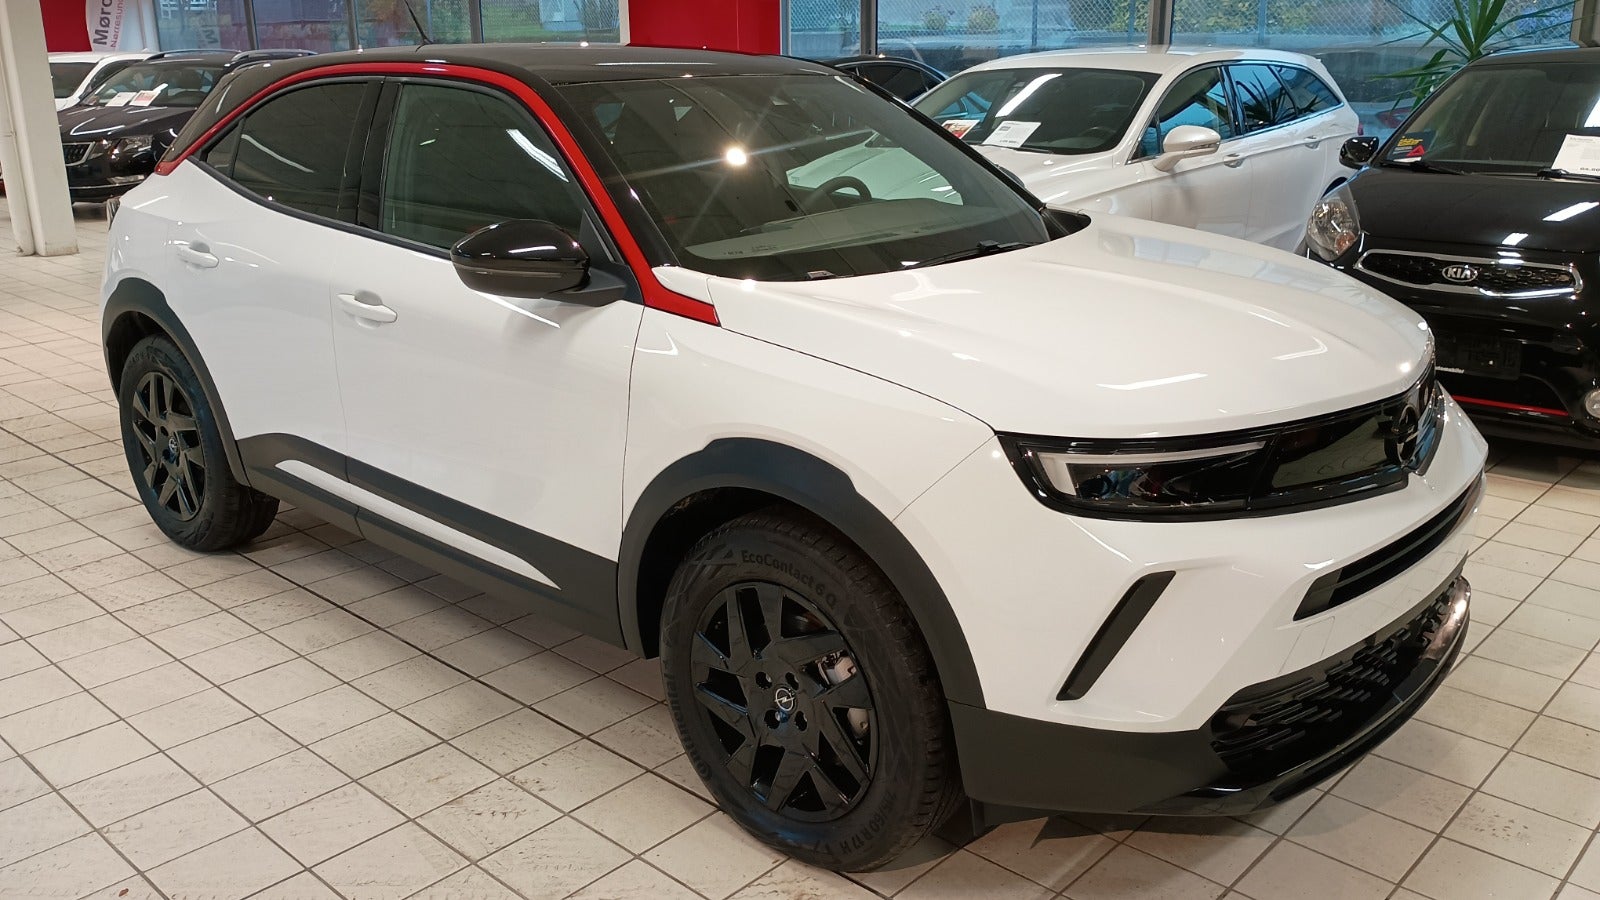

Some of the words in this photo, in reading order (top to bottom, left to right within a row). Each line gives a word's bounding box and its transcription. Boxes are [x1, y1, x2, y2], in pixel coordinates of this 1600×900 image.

[1447, 267, 1471, 279] KIA
[742, 550, 815, 588] EcoContact
[815, 583, 826, 596] 6
[826, 592, 837, 611] Q
